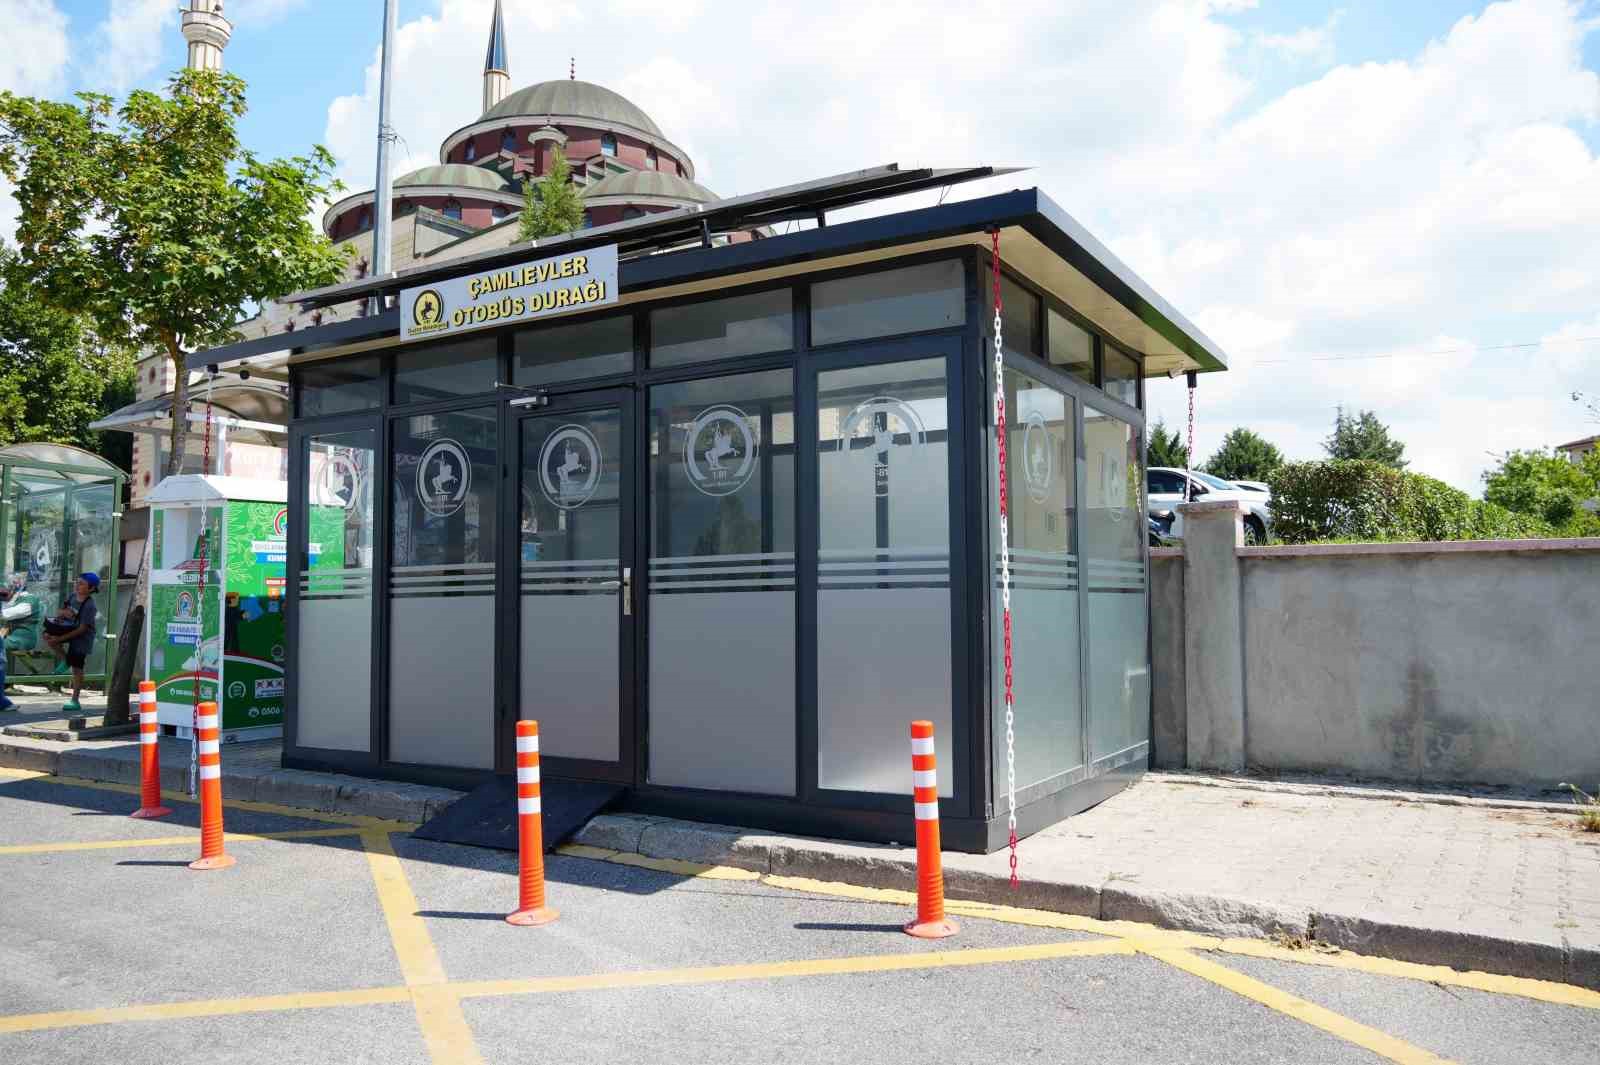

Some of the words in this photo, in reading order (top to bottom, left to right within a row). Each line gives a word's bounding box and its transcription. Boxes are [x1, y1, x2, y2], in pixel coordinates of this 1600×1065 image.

[469, 256, 588, 299] ÇAMLIEVLER
[453, 294, 525, 326] OTOBÜS
[530, 280, 606, 312] DURAĞI
